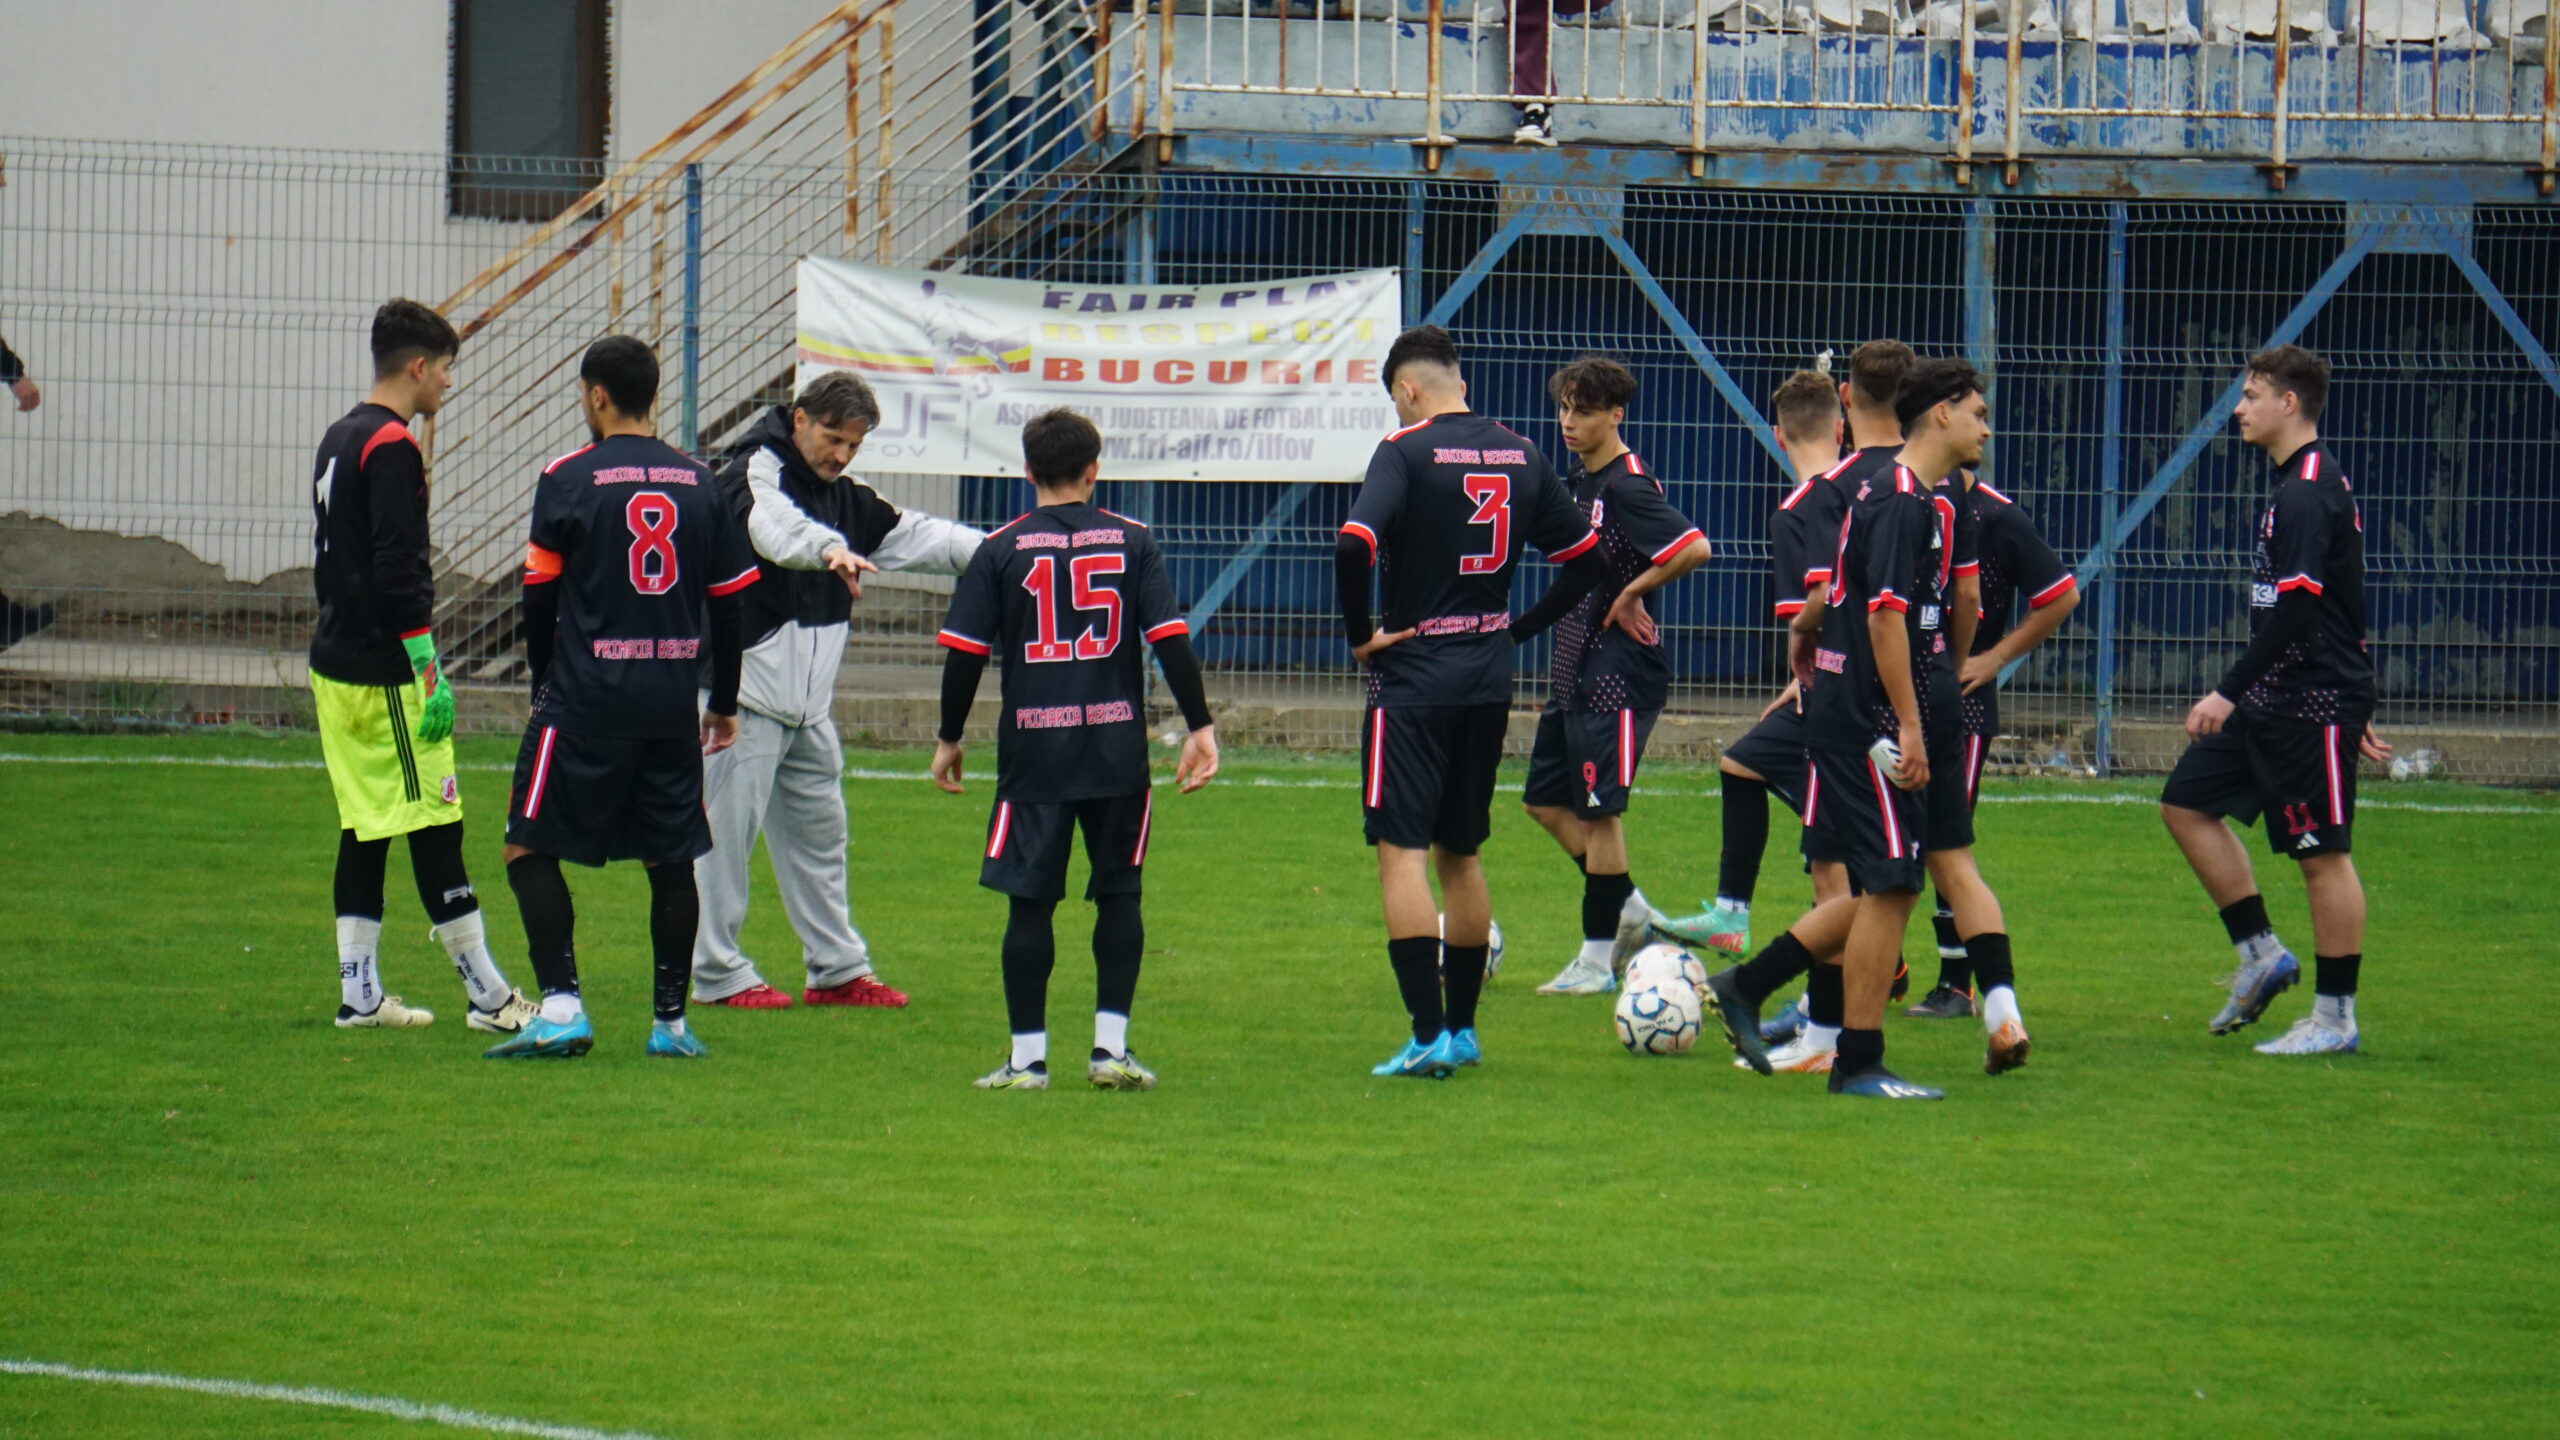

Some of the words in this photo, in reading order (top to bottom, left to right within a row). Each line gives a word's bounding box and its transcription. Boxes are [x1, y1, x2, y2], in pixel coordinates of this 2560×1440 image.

[1042, 291, 1197, 313] FAIR
[1041, 317, 1384, 345] RESPECT
[1042, 357, 1378, 385] BUCURIE
[1224, 407, 1248, 430] DE
[1252, 407, 1326, 430] FOTBAL
[1331, 407, 1387, 430] ILFOV
[1459, 473, 1510, 575] 3
[626, 491, 678, 595] 8
[1021, 553, 1125, 663] 15
[1016, 706, 1082, 729] PRIMARIA
[1583, 761, 1597, 793] 9
[2284, 803, 2319, 835] 11
